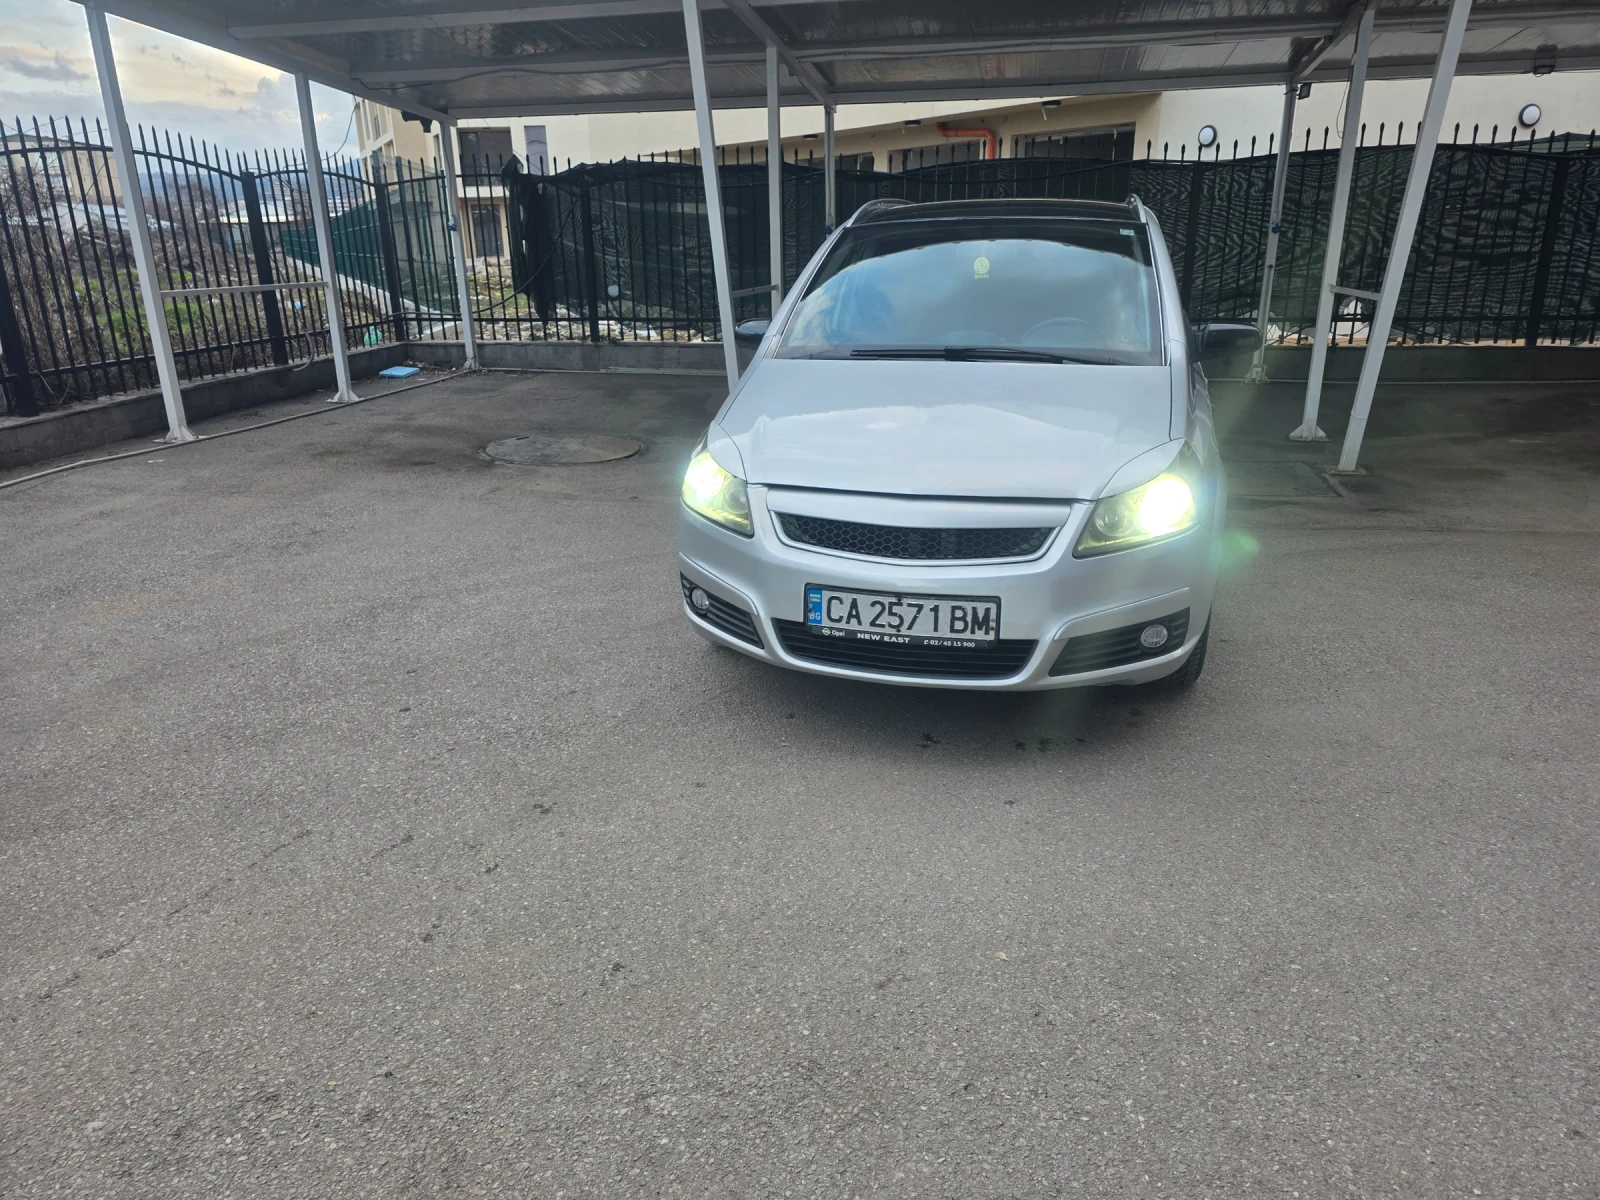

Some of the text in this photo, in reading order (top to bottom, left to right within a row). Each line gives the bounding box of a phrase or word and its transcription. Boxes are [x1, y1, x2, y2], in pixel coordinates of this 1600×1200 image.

[809, 612, 821, 621] BG
[826, 595, 992, 636] CA 2571 BM
[831, 629, 846, 637] Opel
[857, 632, 881, 641] NEW
[883, 635, 911, 644] EAST
